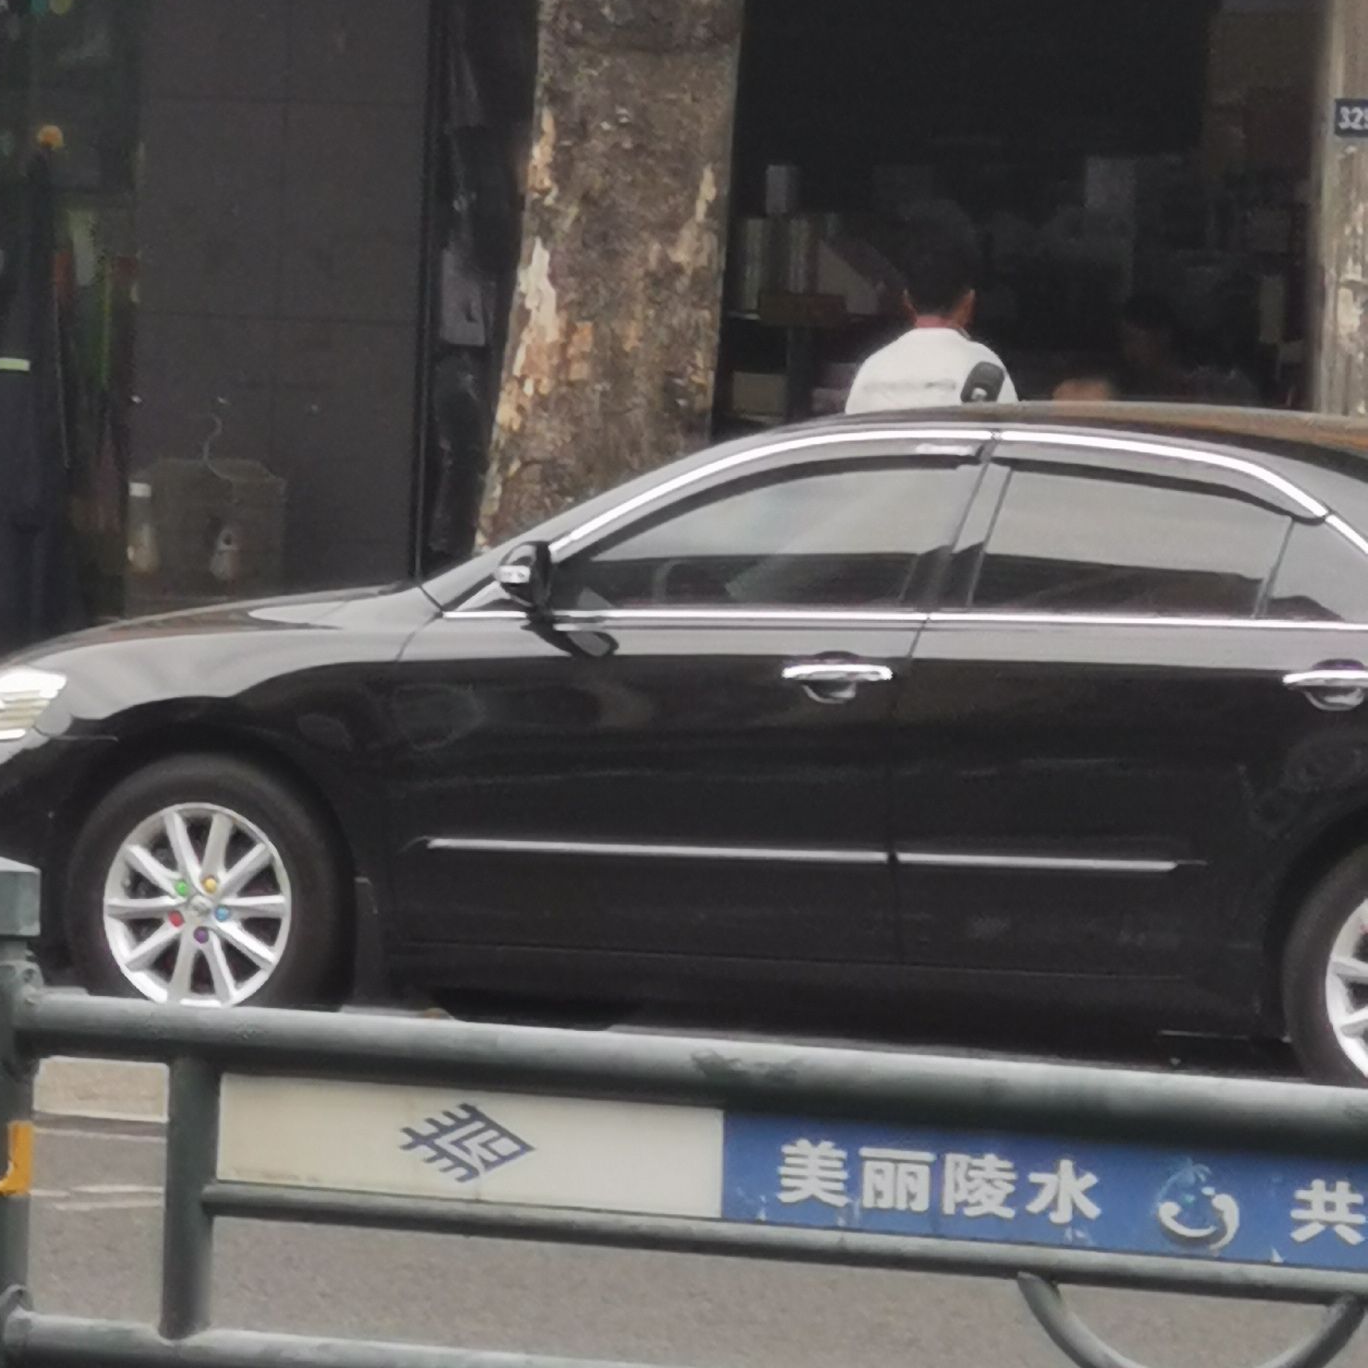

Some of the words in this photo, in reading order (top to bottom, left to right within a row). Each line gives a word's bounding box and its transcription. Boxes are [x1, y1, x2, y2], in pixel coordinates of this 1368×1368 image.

[777, 1138, 1102, 1224] 美丽陵水
[1290, 1178, 1367, 1246] 共
